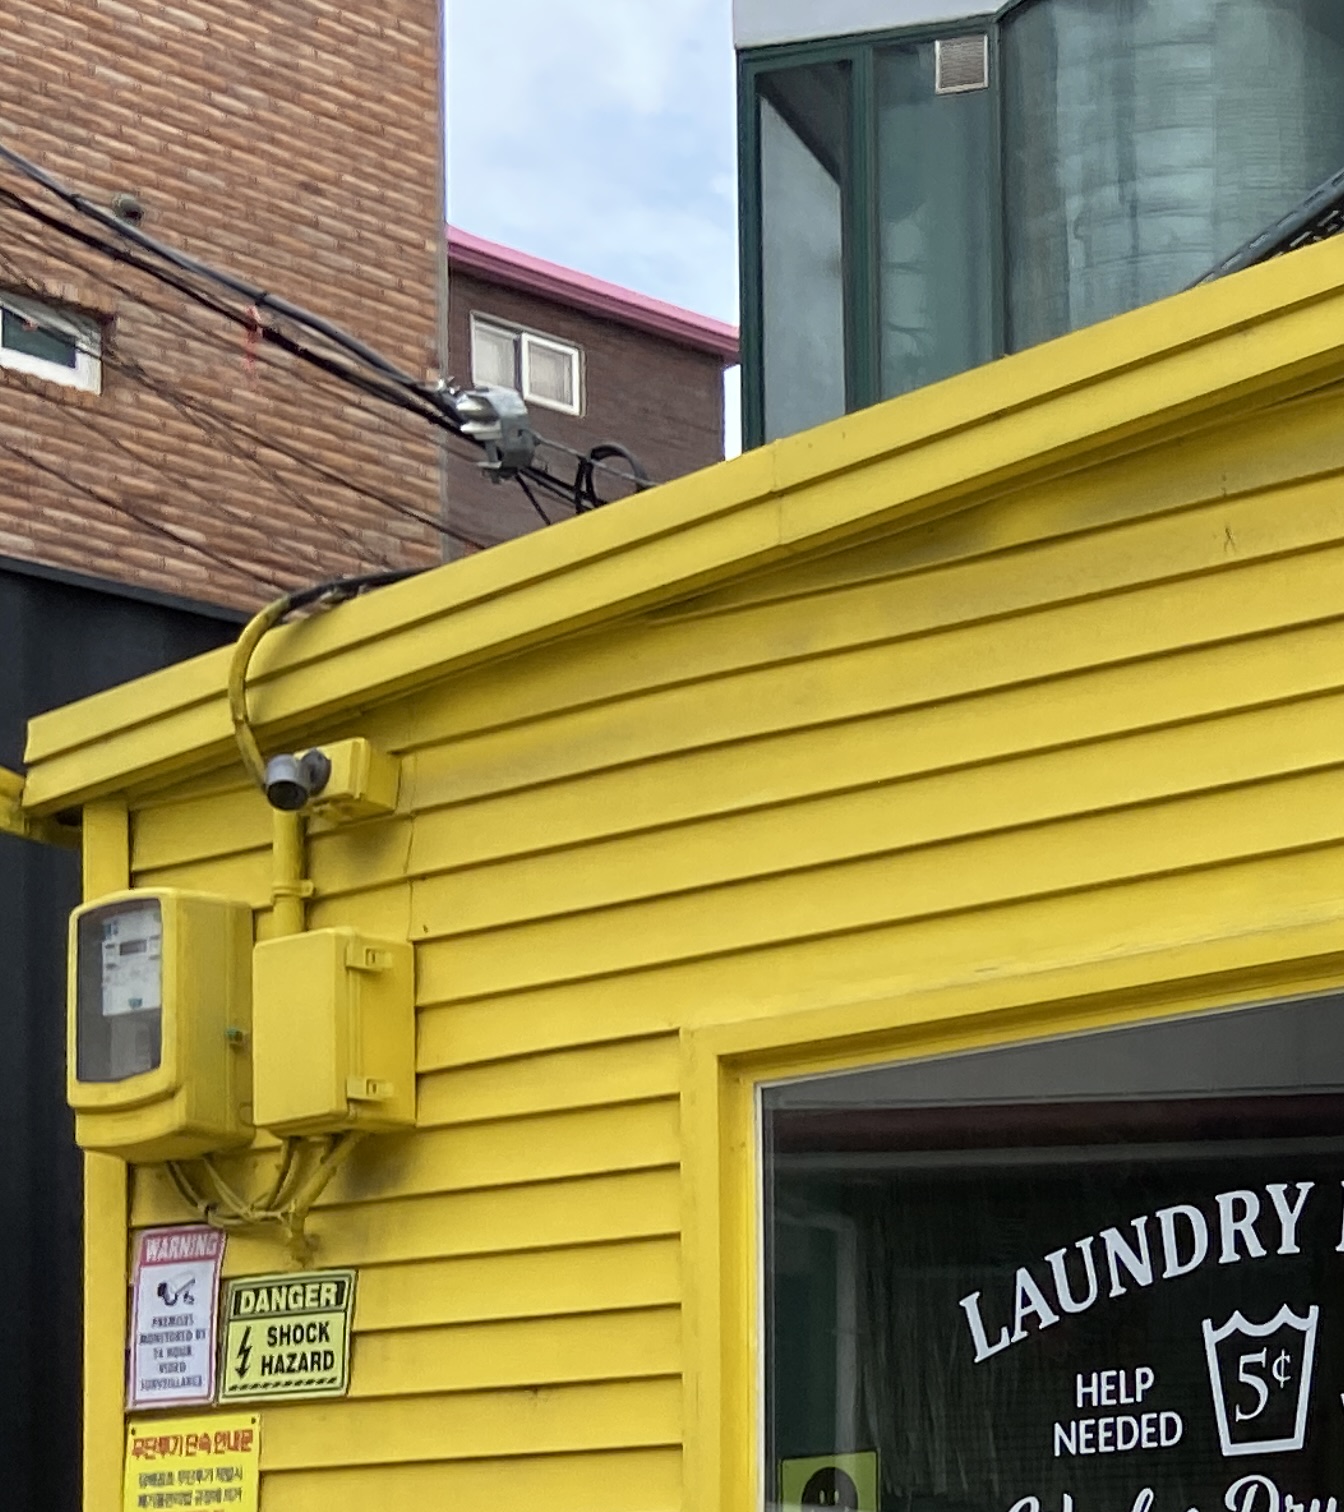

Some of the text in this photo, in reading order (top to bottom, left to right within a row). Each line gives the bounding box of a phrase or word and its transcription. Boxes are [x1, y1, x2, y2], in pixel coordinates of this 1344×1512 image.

[146, 1233, 218, 1261] WARNING
[959, 1182, 1314, 1363] LAUNDRY
[240, 1282, 338, 1314] DANGER
[267, 1322, 330, 1347] SHOCK
[261, 1350, 335, 1376] HAZARD
[1075, 1366, 1155, 1410] HELP
[132, 1434, 183, 1460] 무단투기
[214, 1429, 254, 1454] 안내문
[1052, 1411, 1183, 1457] NEEDED
